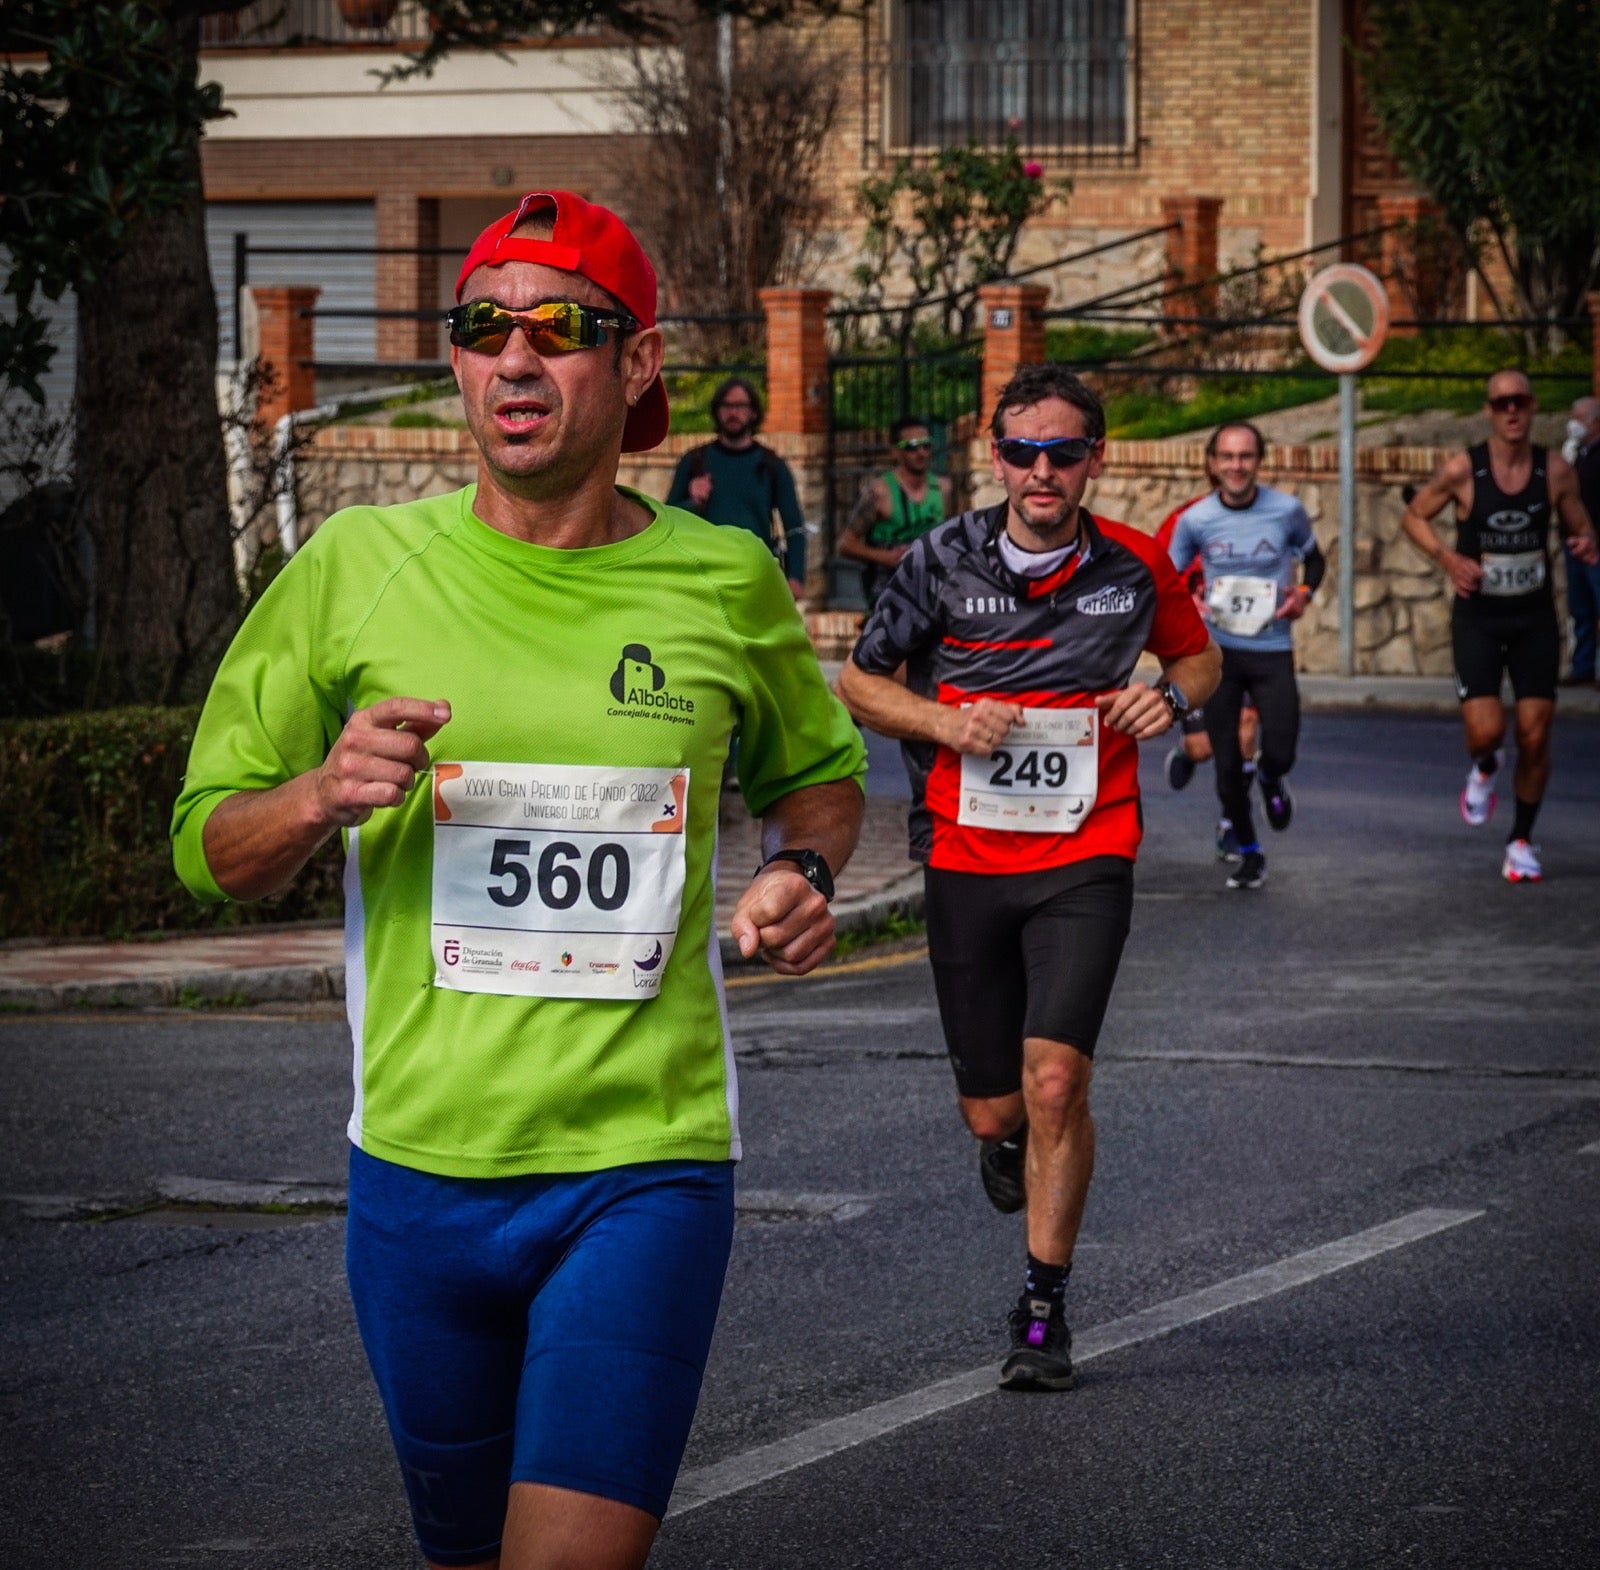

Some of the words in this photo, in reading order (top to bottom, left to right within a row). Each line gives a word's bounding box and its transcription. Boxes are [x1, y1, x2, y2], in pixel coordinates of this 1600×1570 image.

[965, 597, 1017, 614] GOBIK
[1231, 596, 1255, 613] 57
[627, 688, 694, 712] Albolote
[651, 711, 661, 721] de
[662, 713, 695, 726] Deportes
[989, 750, 1067, 788] 249
[464, 778, 494, 797] XXXV
[498, 779, 526, 798] GRAN
[531, 780, 570, 800] PREMIO
[574, 785, 588, 801] DE
[592, 782, 626, 802] FONDO
[630, 783, 658, 802] 2022
[523, 802, 568, 820] UNIVERSO
[571, 804, 600, 821] LORCA
[487, 838, 631, 911] 560
[462, 946, 503, 957] Diputación
[462, 956, 471, 964] de
[472, 957, 503, 966] Granada
[633, 969, 659, 988] Lorca
